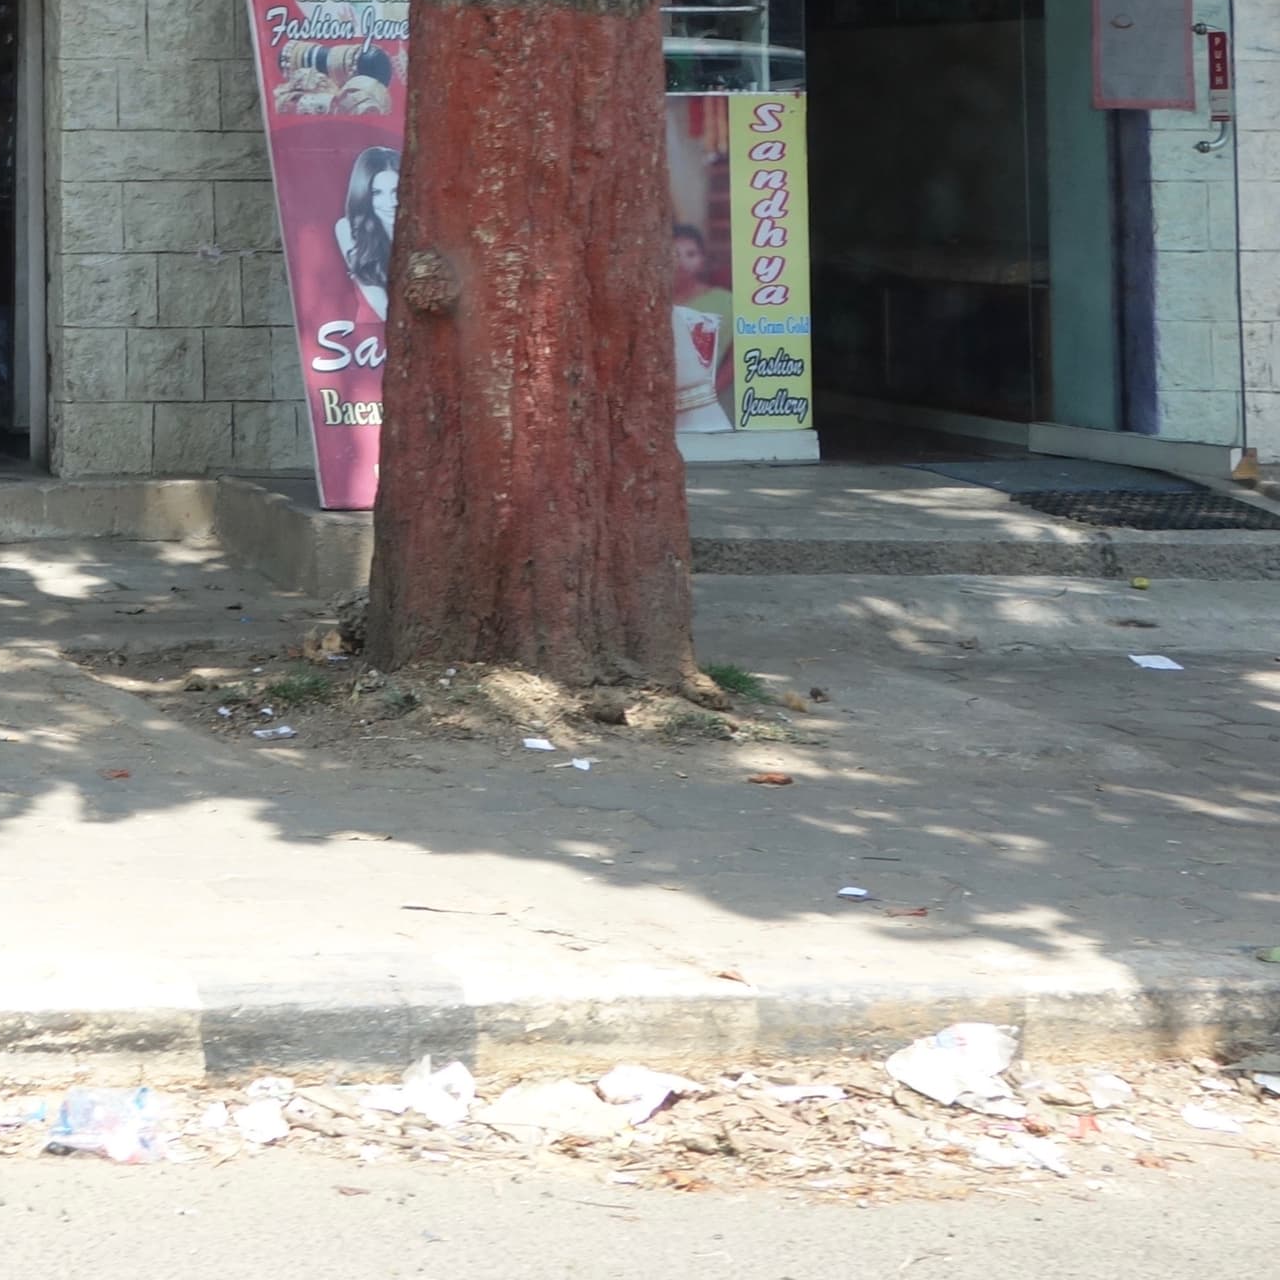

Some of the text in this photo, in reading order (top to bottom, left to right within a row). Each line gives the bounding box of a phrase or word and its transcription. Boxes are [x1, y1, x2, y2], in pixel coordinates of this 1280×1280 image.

[266, 5, 355, 47] Fashion
[737, 315, 809, 334] One Gram Gold
[311, 320, 387, 372] Sa
[743, 346, 805, 384] Fashion
[740, 386, 809, 428] Jewellery
